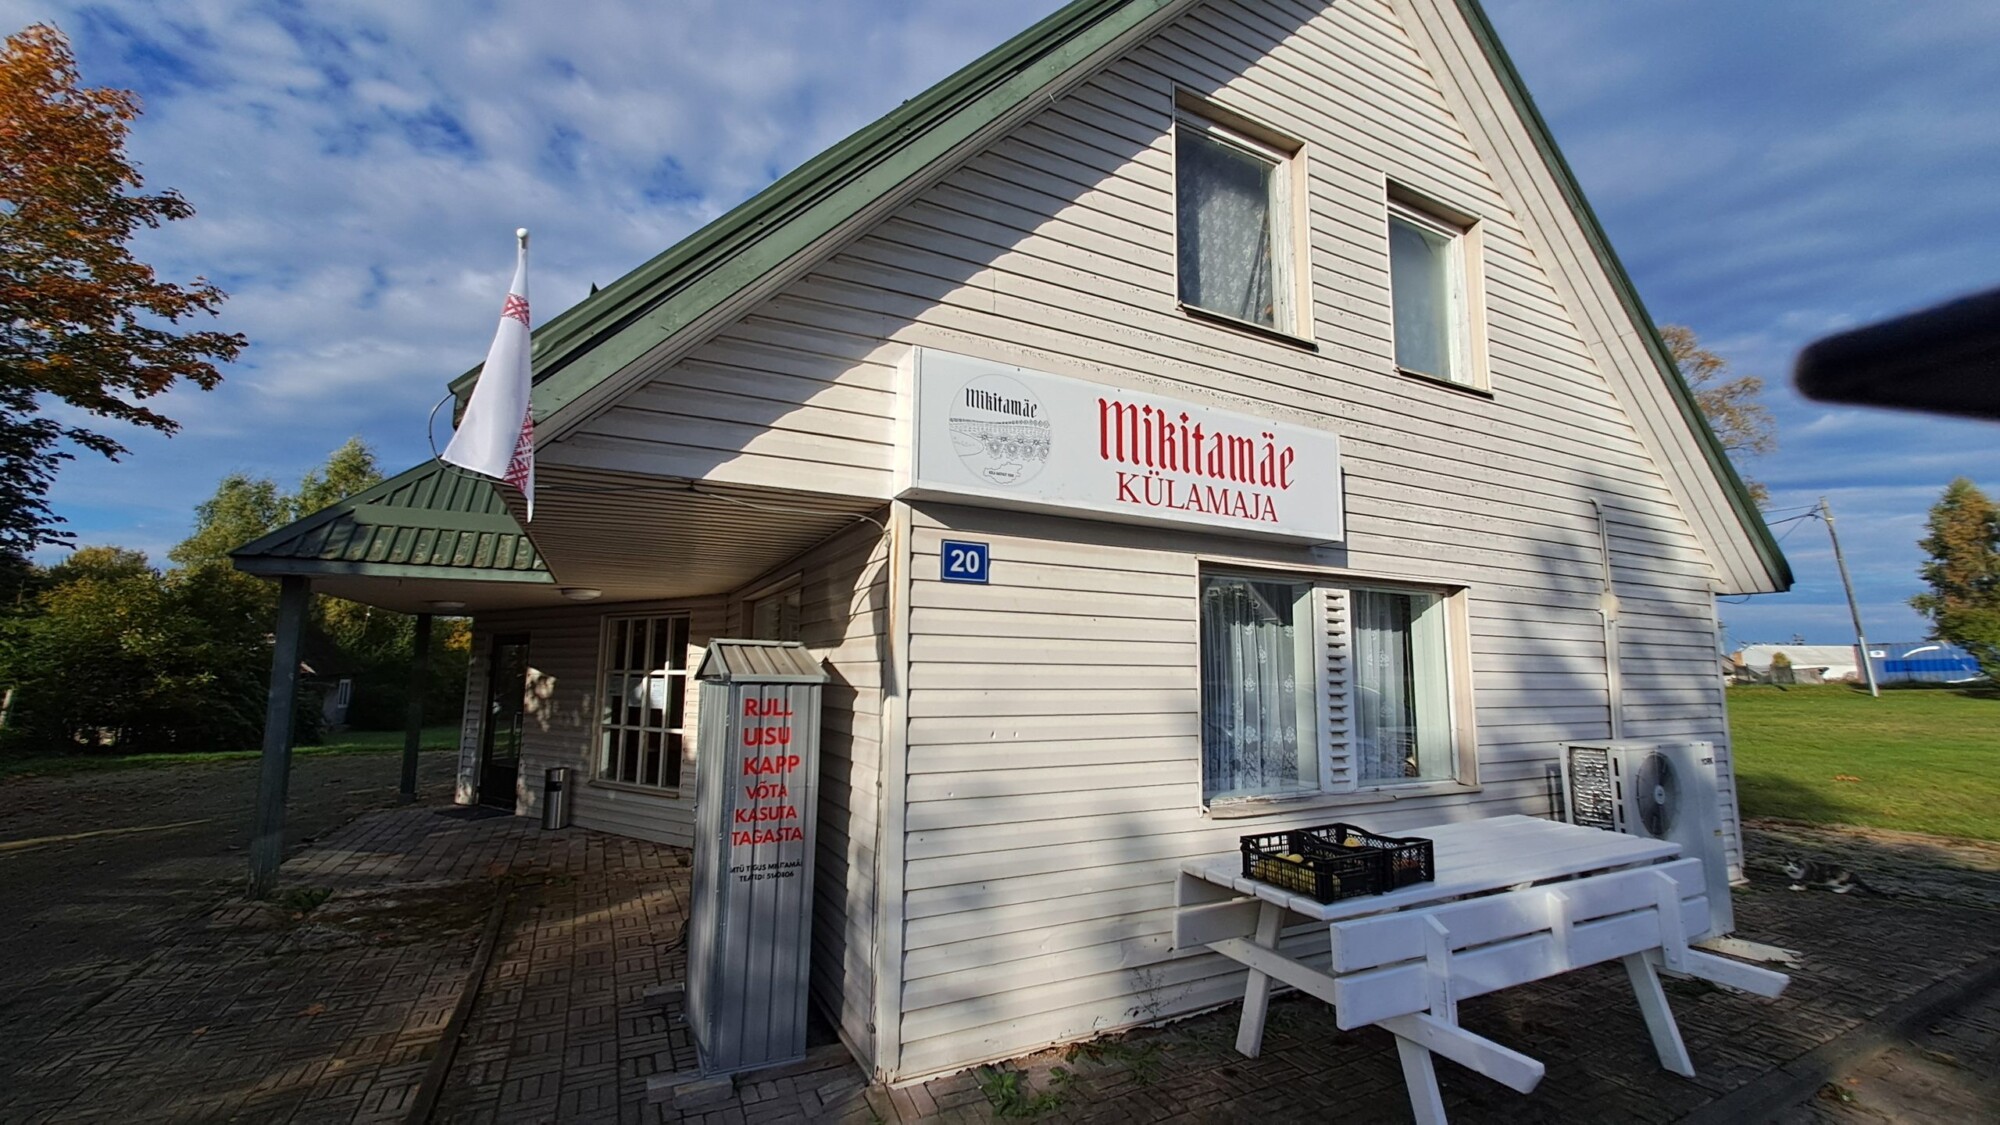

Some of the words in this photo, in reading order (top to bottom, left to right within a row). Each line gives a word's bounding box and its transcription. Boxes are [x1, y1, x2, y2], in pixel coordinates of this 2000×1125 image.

[965, 387, 1037, 418] Mikitamäe
[1098, 398, 1295, 490] Mikitamäe
[1115, 470, 1279, 523] KÜLAMAJA
[950, 549, 980, 573] 20
[744, 698, 793, 716] RULL
[743, 726, 790, 746] UISU
[743, 754, 800, 776] KAPP
[745, 780, 787, 800] VÕTA
[735, 805, 797, 823] KASUTA
[731, 826, 803, 846] TAGASTA
